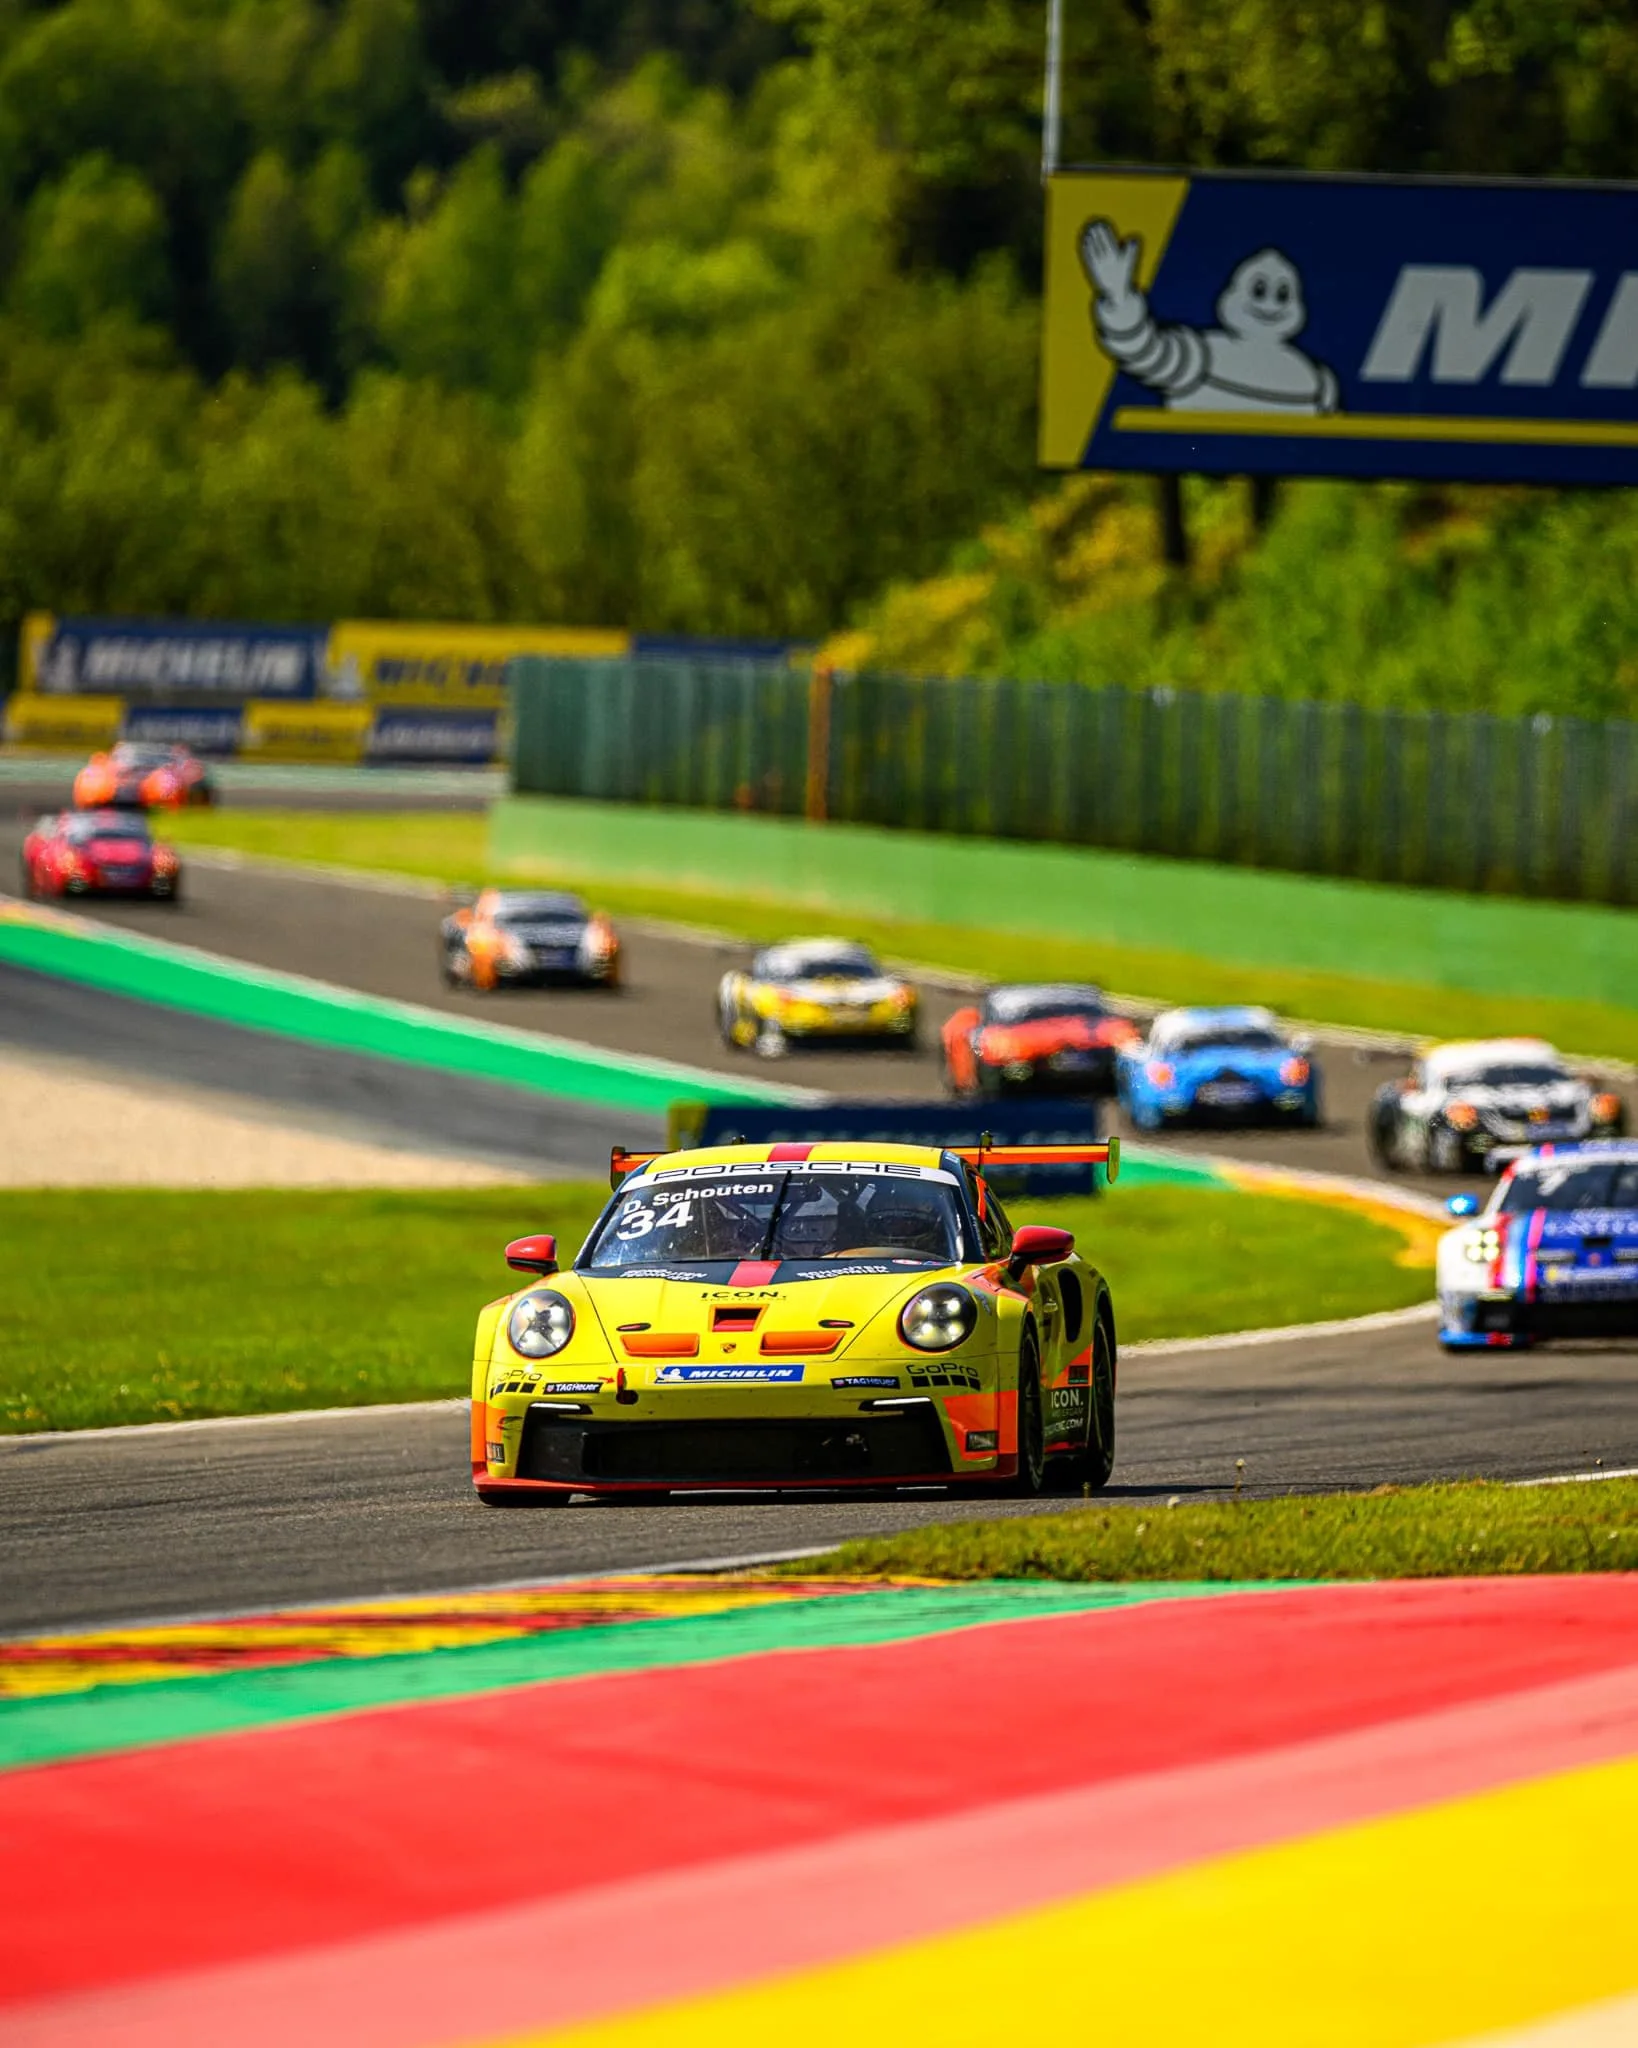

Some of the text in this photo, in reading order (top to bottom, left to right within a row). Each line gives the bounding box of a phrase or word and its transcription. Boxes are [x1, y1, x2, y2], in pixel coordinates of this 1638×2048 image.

[654, 1161, 921, 1182] PORSCHE
[624, 1182, 773, 1214] D. Schouten
[616, 1201, 693, 1240] 34
[701, 1291, 786, 1299] ICON.
[689, 1370, 793, 1379] MICHELIN
[905, 1363, 978, 1377] GoPro
